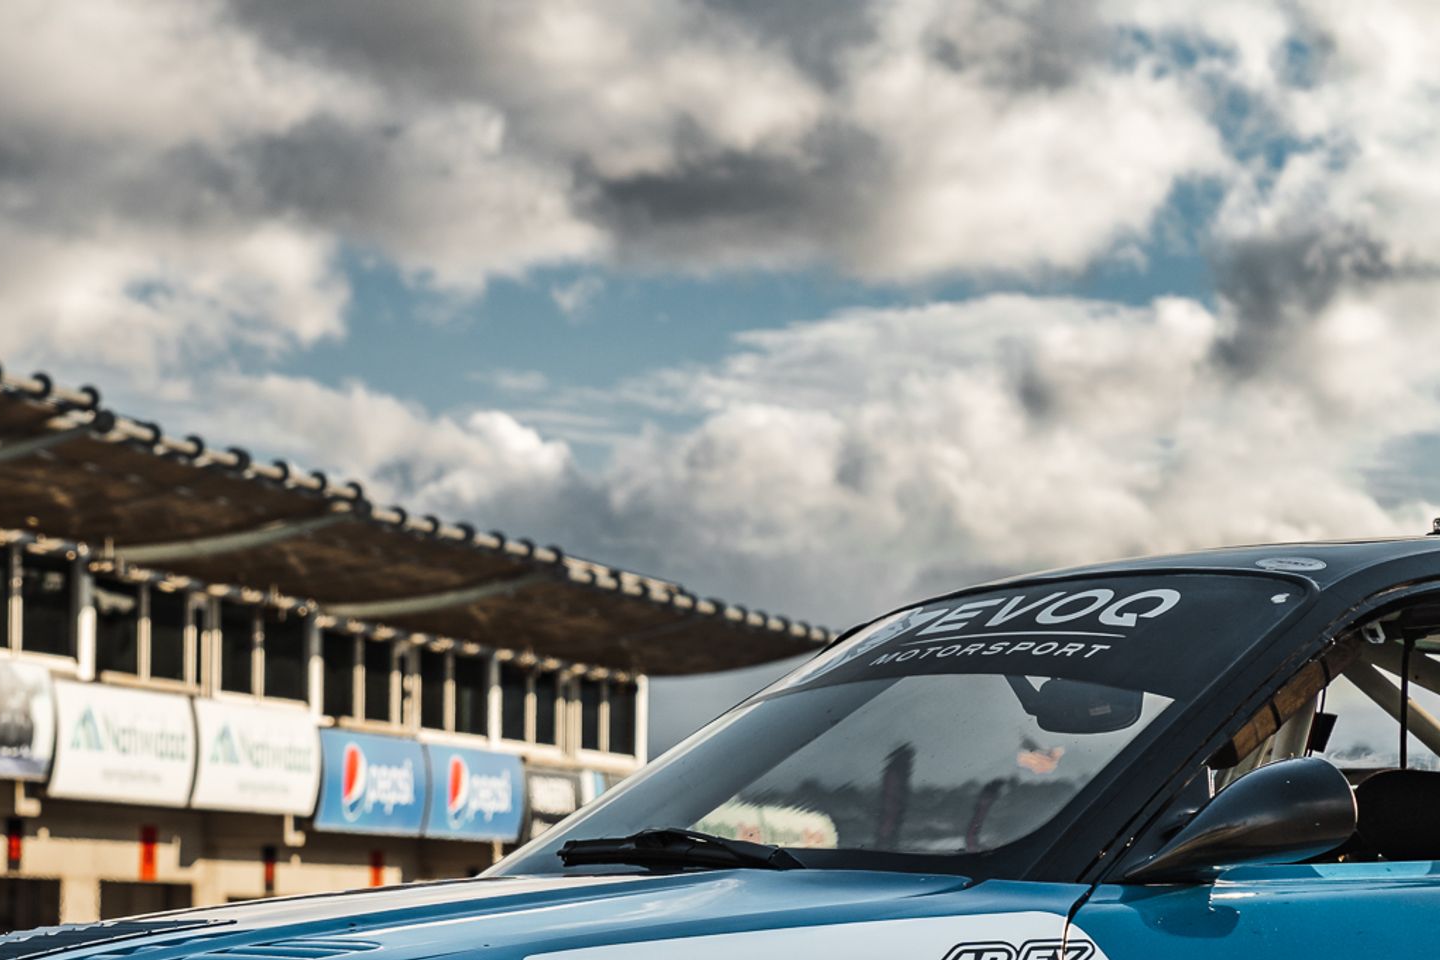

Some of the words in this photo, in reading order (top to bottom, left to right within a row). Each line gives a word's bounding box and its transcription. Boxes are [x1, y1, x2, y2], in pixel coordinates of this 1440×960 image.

[916, 588, 1181, 636] EVOQ
[869, 641, 1112, 666] MOTORSPORT
[364, 758, 415, 815] pepsi
[466, 768, 513, 823] pepsi
